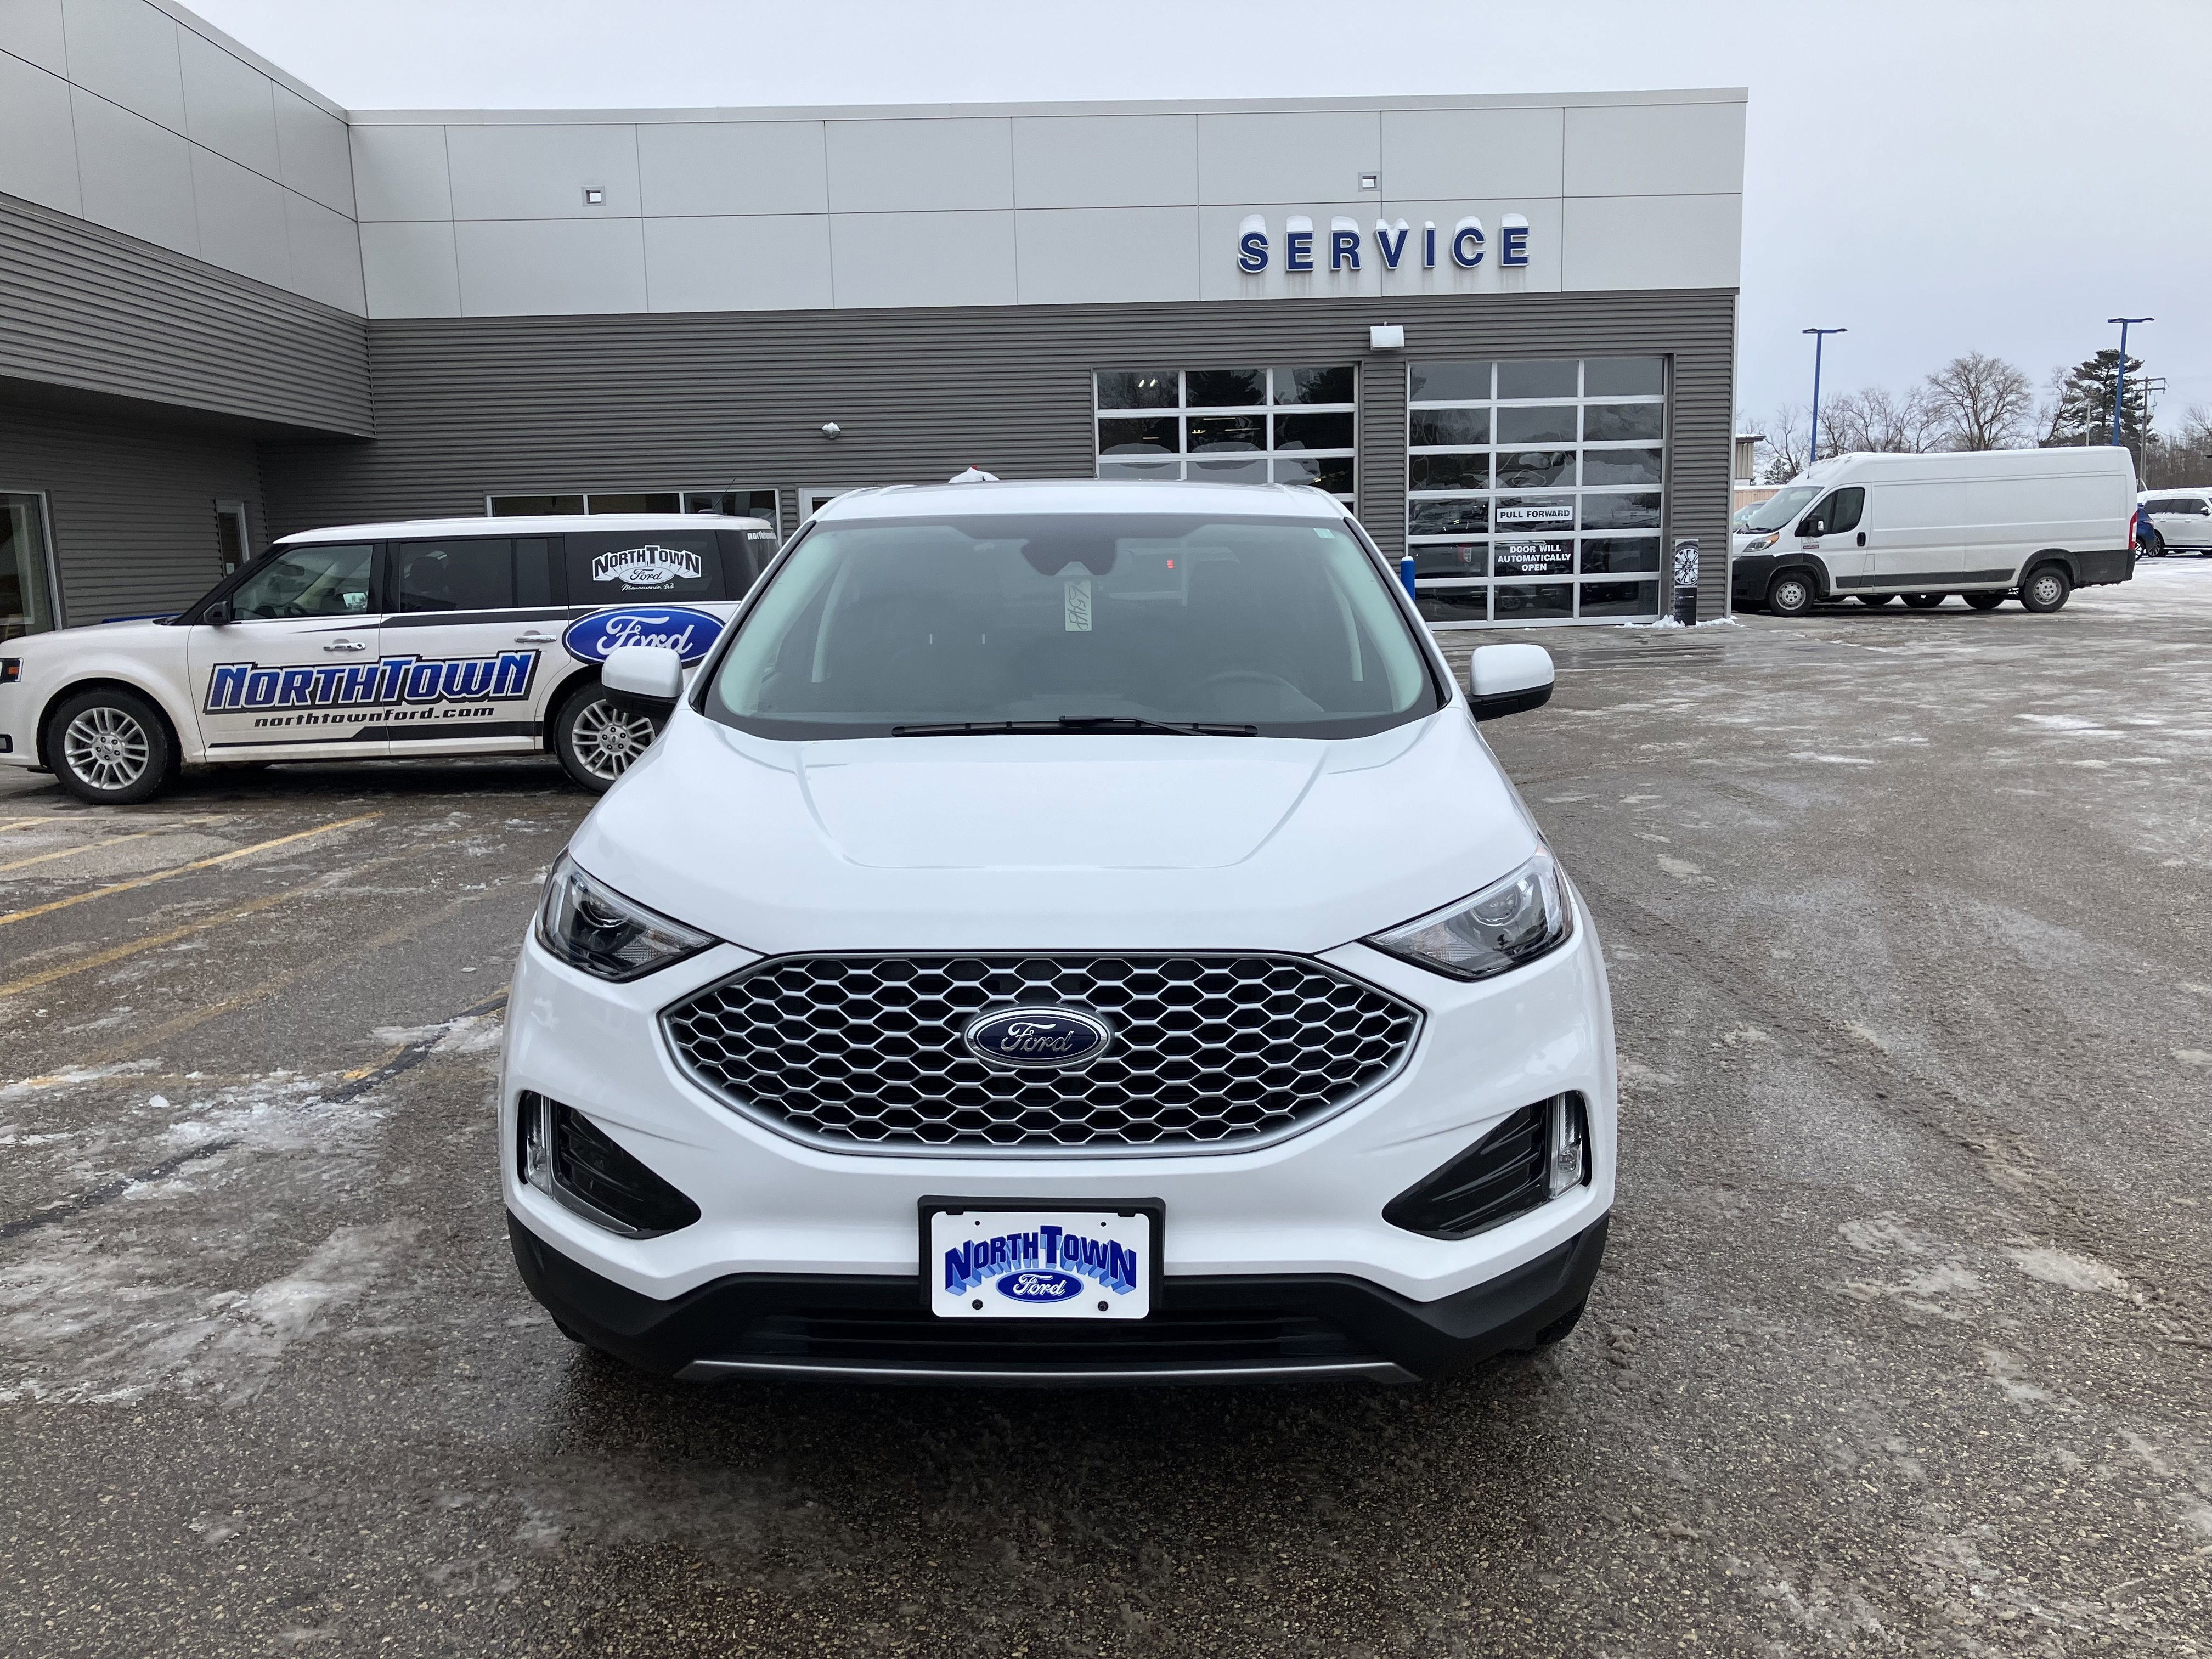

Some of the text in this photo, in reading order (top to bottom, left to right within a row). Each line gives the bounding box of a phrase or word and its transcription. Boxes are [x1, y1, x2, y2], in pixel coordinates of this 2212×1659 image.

[1238, 225, 1530, 273] SERVICE
[1497, 554, 1572, 563] AUTOMATICALLY
[630, 568, 662, 580] Ford
[596, 615, 695, 654] Ford
[254, 707, 494, 727] northtownford.com
[1000, 1022, 1074, 1052] Ford
[1012, 1273, 1066, 1296] Ford
